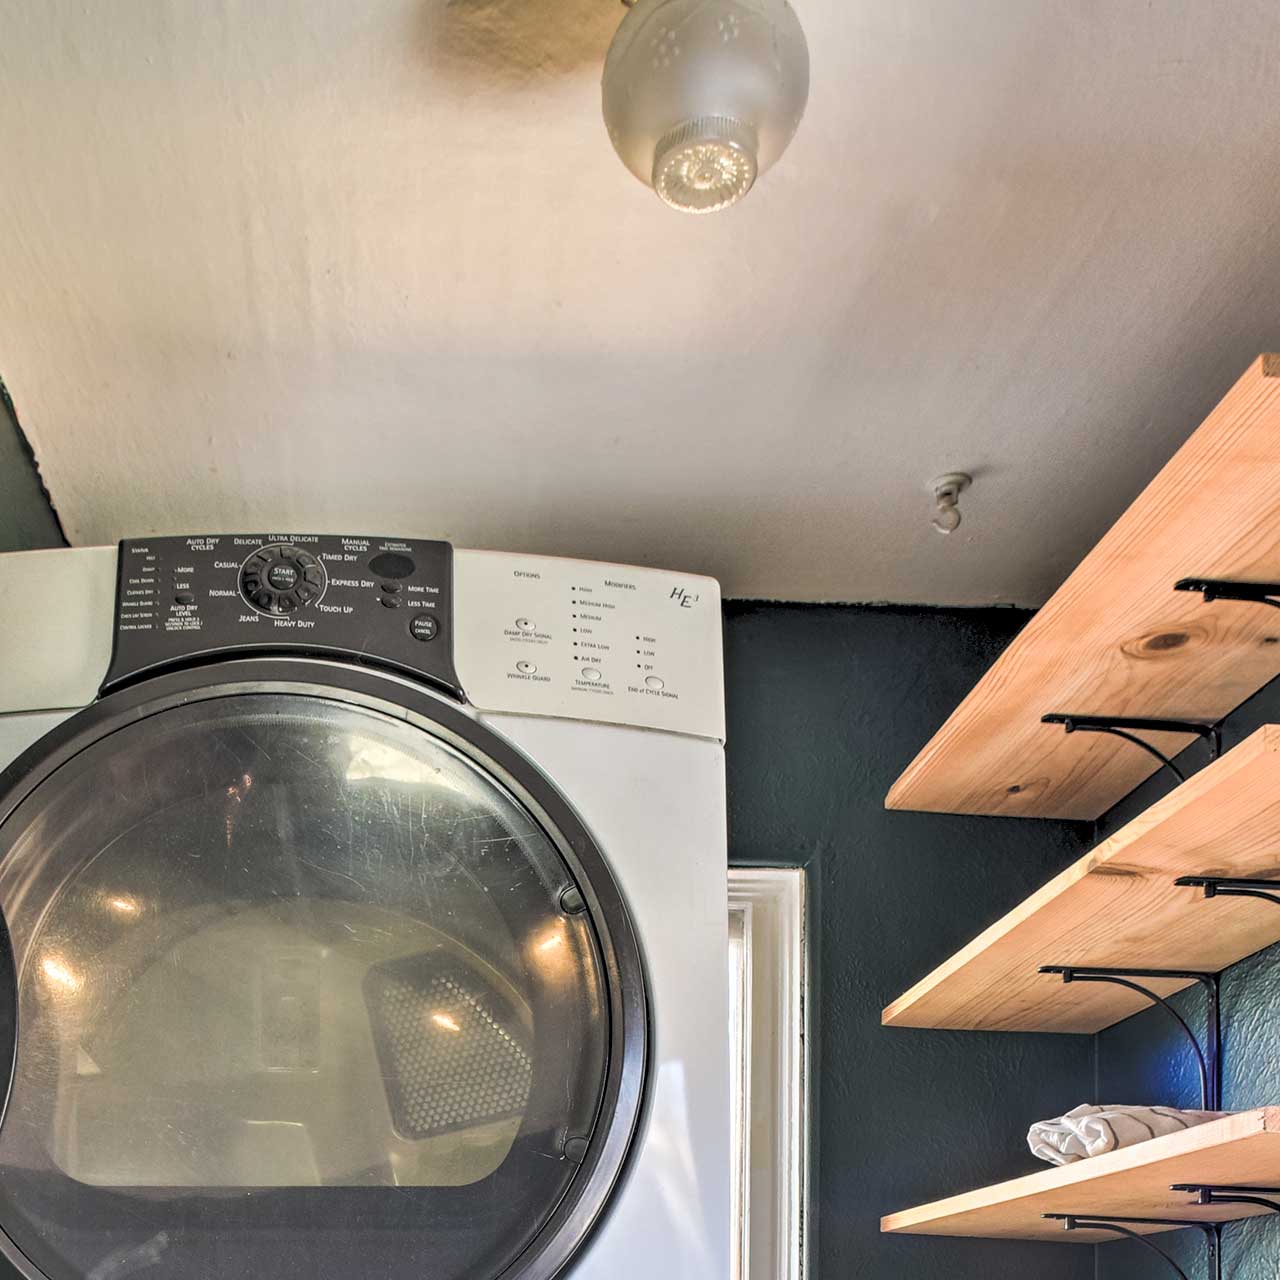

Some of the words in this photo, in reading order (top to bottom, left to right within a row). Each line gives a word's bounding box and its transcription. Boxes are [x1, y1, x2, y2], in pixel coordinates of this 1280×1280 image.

[187, 538, 203, 546] AUTO
[205, 538, 219, 546] DRY
[341, 538, 370, 546] MANUAL
[322, 553, 342, 561] TIMED
[513, 571, 541, 579] OPTIONS
[332, 579, 359, 587] EXPRESS
[320, 605, 341, 613] TOUCH
